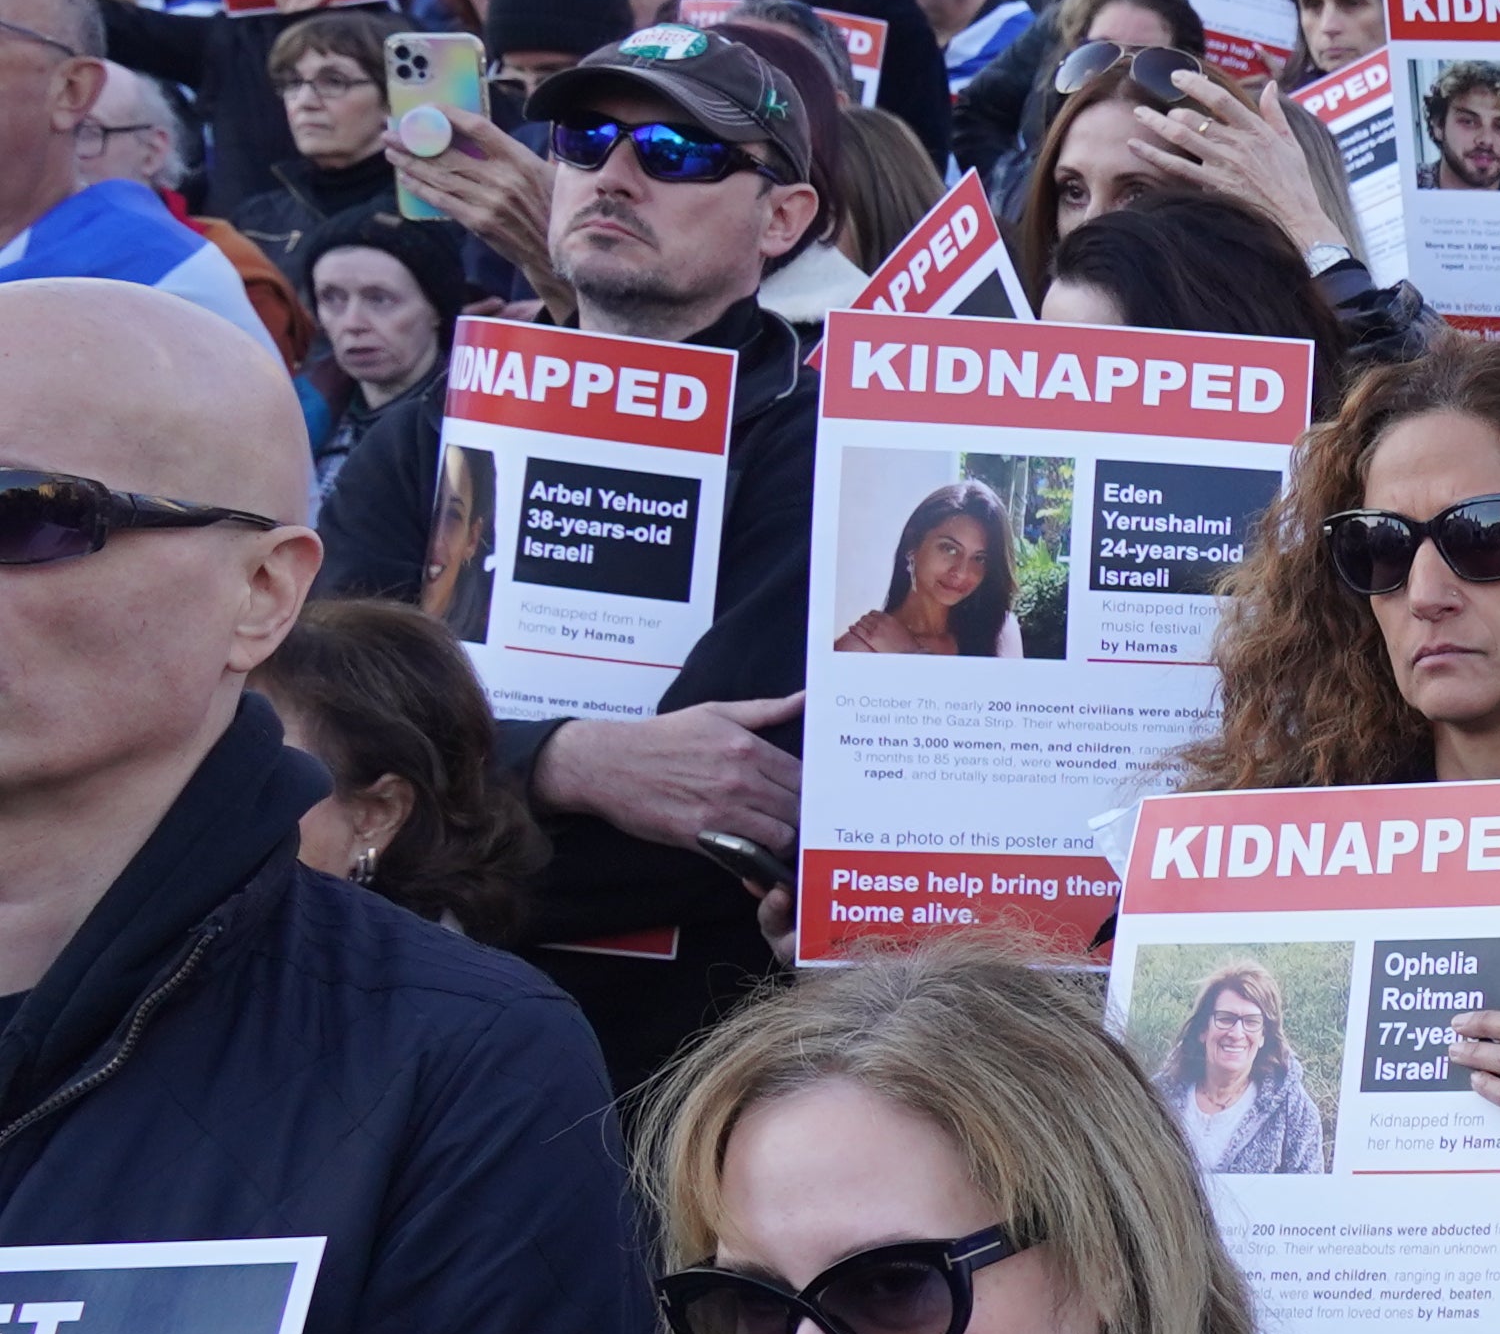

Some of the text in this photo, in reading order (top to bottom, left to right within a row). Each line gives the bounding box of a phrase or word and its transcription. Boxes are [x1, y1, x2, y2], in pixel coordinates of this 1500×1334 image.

[852, 342, 1284, 413] KIDNAPPED
[529, 480, 688, 519] Arbel Yehuod
[1104, 482, 1163, 505] Eden
[527, 508, 672, 545] 38-years-old
[1102, 510, 1231, 535] Yerushalmi
[524, 536, 594, 564] Israeli
[1100, 537, 1243, 563] 24-years-old
[1099, 565, 1169, 588] Israeli
[1101, 639, 1178, 654] by Hamas
[832, 869, 920, 893] Please
[927, 871, 984, 898] help
[991, 873, 1058, 901] bring
[831, 900, 979, 924] home alive.
[1385, 951, 1477, 982] Ophelia
[1381, 986, 1483, 1011] Roitman
[1375, 1056, 1449, 1081] Israeli
